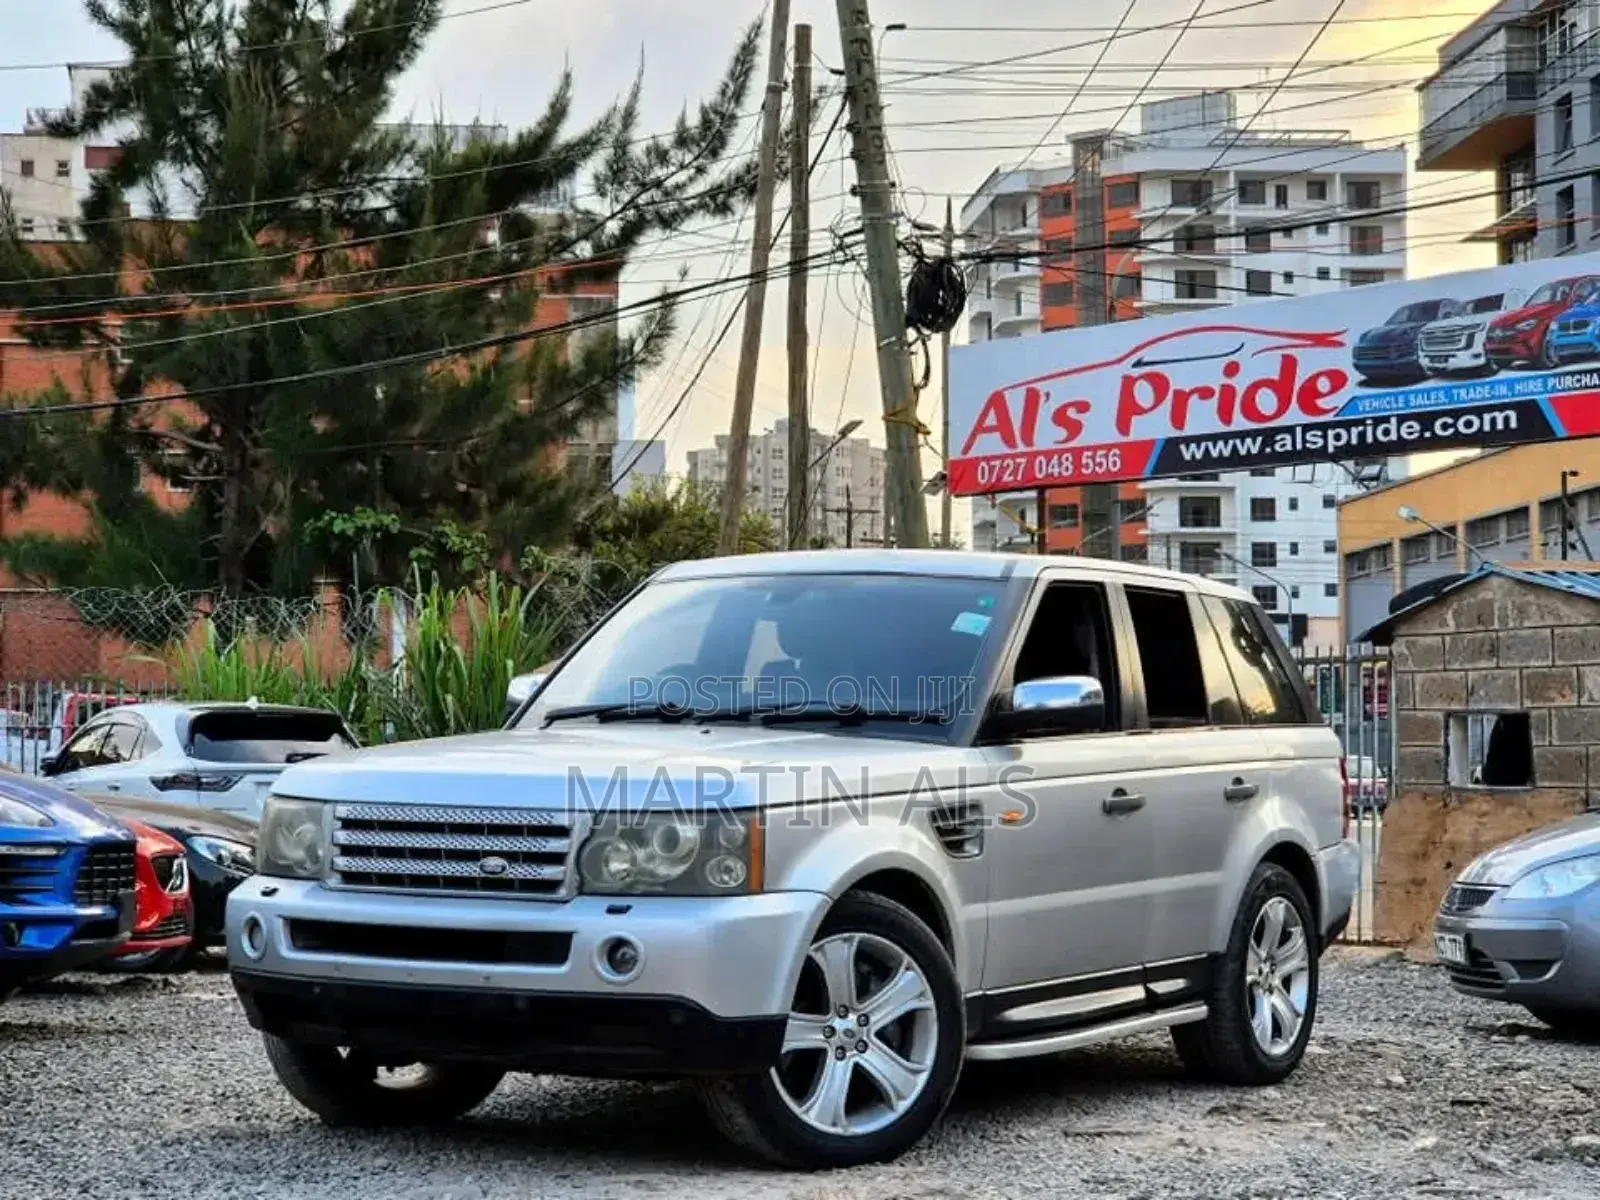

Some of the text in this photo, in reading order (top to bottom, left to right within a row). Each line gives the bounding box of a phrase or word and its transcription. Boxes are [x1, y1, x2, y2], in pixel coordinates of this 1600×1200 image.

[960, 353, 1349, 456] Al's Pride
[1358, 396, 1405, 412] VEHICLE
[1451, 384, 1512, 401] TRADE-IN,
[1514, 380, 1544, 395] HIRE
[1546, 372, 1600, 390] PURCHA
[1178, 408, 1518, 461] www.alspride.com
[976, 448, 1122, 485] 0727 048 556
